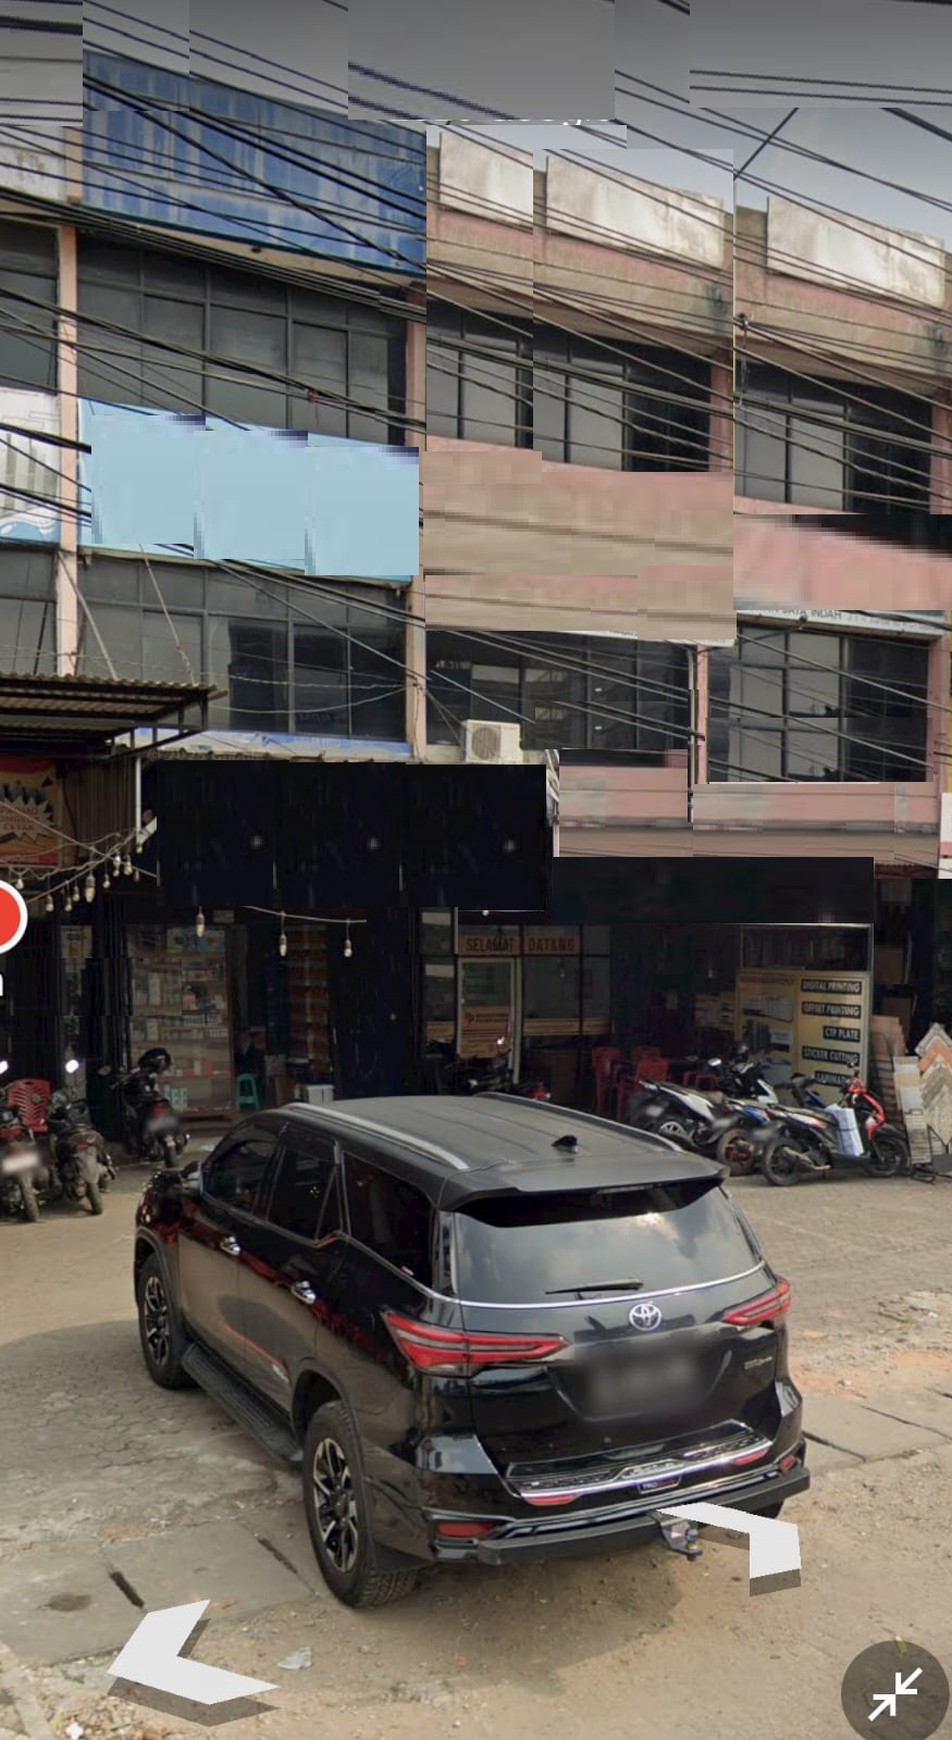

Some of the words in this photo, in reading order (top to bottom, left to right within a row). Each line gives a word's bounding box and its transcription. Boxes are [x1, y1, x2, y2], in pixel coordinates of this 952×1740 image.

[529, 937, 575, 953] DATANG
[803, 981, 827, 991] DIGITAL
[827, 982, 860, 993] PRINTING
[803, 1003, 825, 1014] OFFSET
[826, 1005, 860, 1017] PRINTING
[825, 1027, 838, 1037] CTP
[838, 1029, 859, 1040] PLATE
[803, 1047, 829, 1060] STICKER
[829, 1050, 858, 1064] CUTTING
